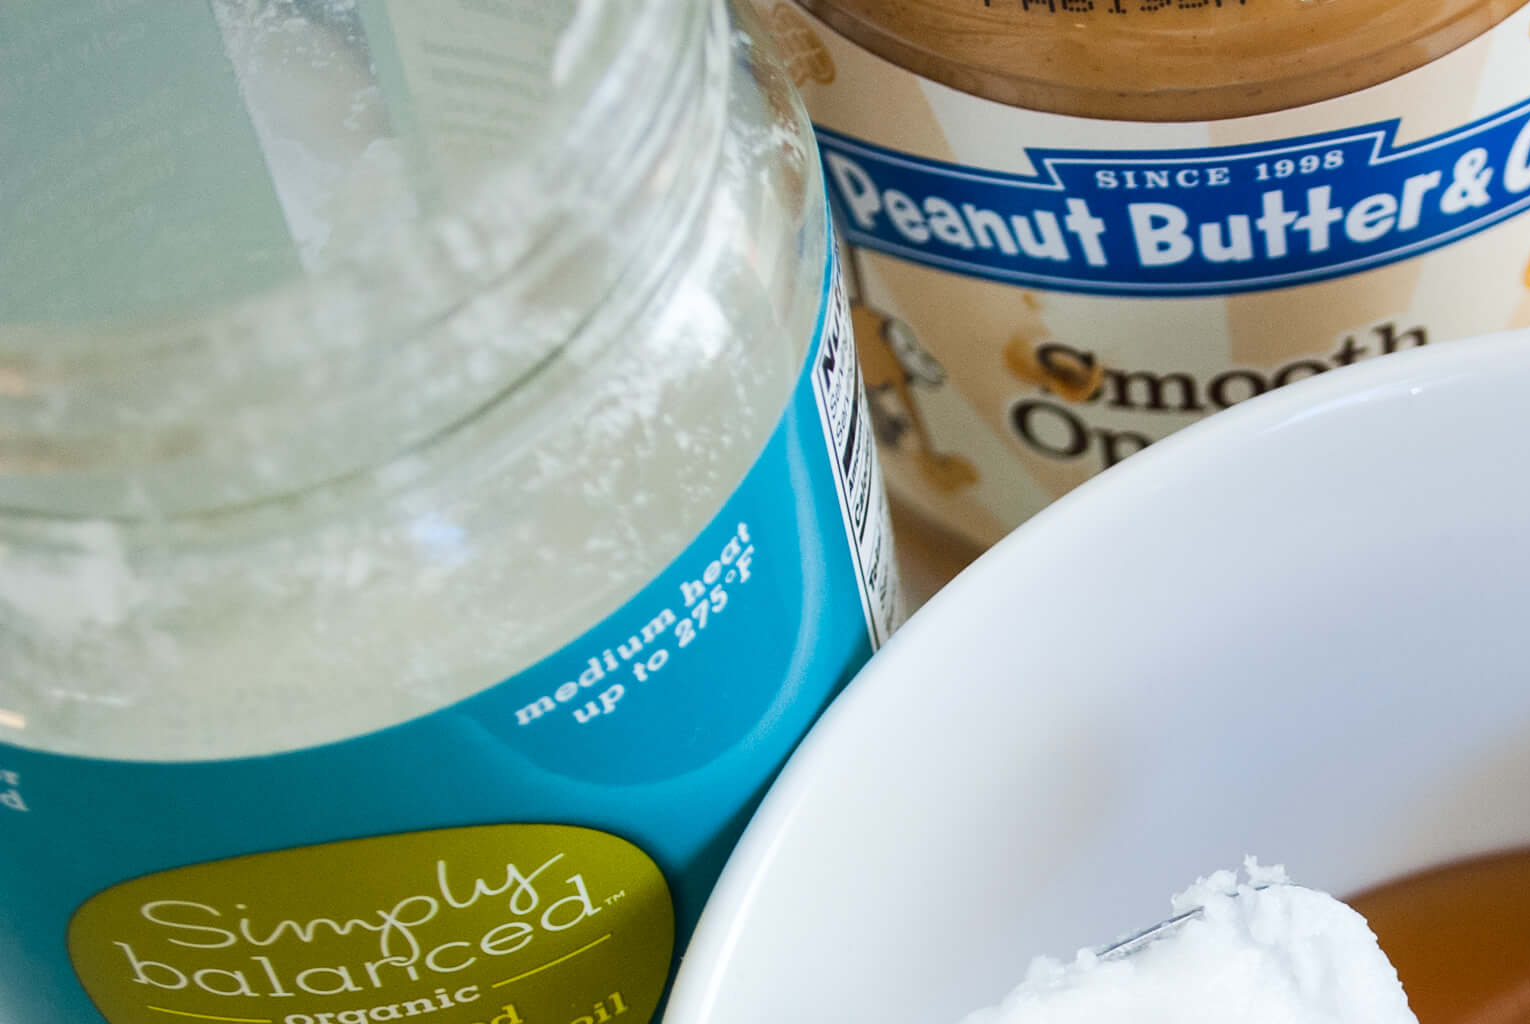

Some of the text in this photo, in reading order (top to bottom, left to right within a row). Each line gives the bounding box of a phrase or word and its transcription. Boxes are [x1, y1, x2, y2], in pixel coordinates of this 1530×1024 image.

[828, 153, 1109, 267] Peanut
[1129, 172, 1440, 269] Butter
[1096, 149, 1345, 192] SINCE 1998
[515, 608, 677, 726] medium
[680, 521, 751, 607] heat
[571, 682, 624, 724] up
[631, 648, 669, 682] to
[113, 874, 603, 999] balanced
[139, 852, 564, 967] Simply
